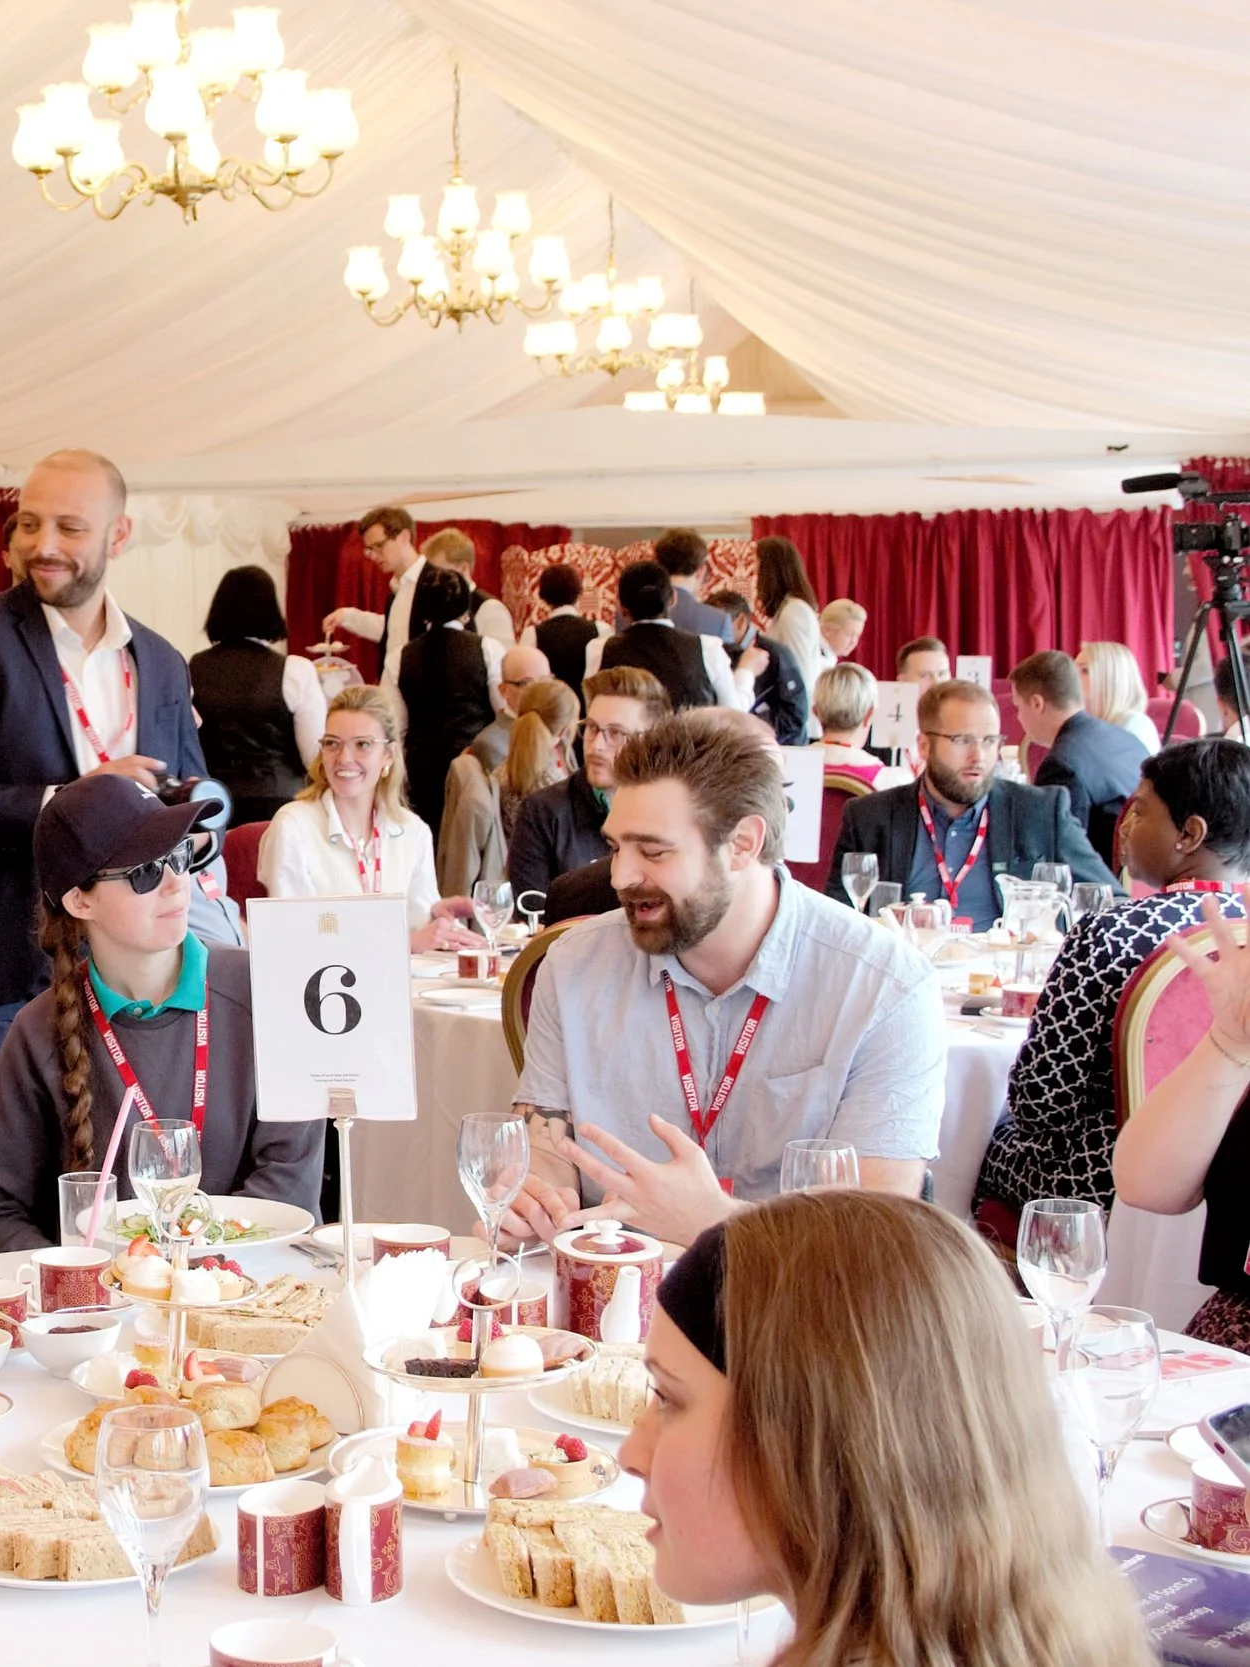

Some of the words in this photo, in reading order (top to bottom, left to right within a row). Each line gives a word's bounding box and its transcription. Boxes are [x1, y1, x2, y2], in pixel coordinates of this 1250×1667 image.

[83, 978, 98, 1013] VISITOR
[303, 964, 362, 1035] 6
[197, 1009, 208, 1047] VISITOR
[670, 1013, 686, 1052] VISITOR
[734, 1018, 758, 1056] VISITOR
[103, 1029, 126, 1066] VISITOR
[130, 1081, 154, 1121] VISITOR
[193, 1069, 207, 1107] VISITOR
[681, 1072, 699, 1112] VISITOR
[710, 1075, 735, 1112] VISITOR
